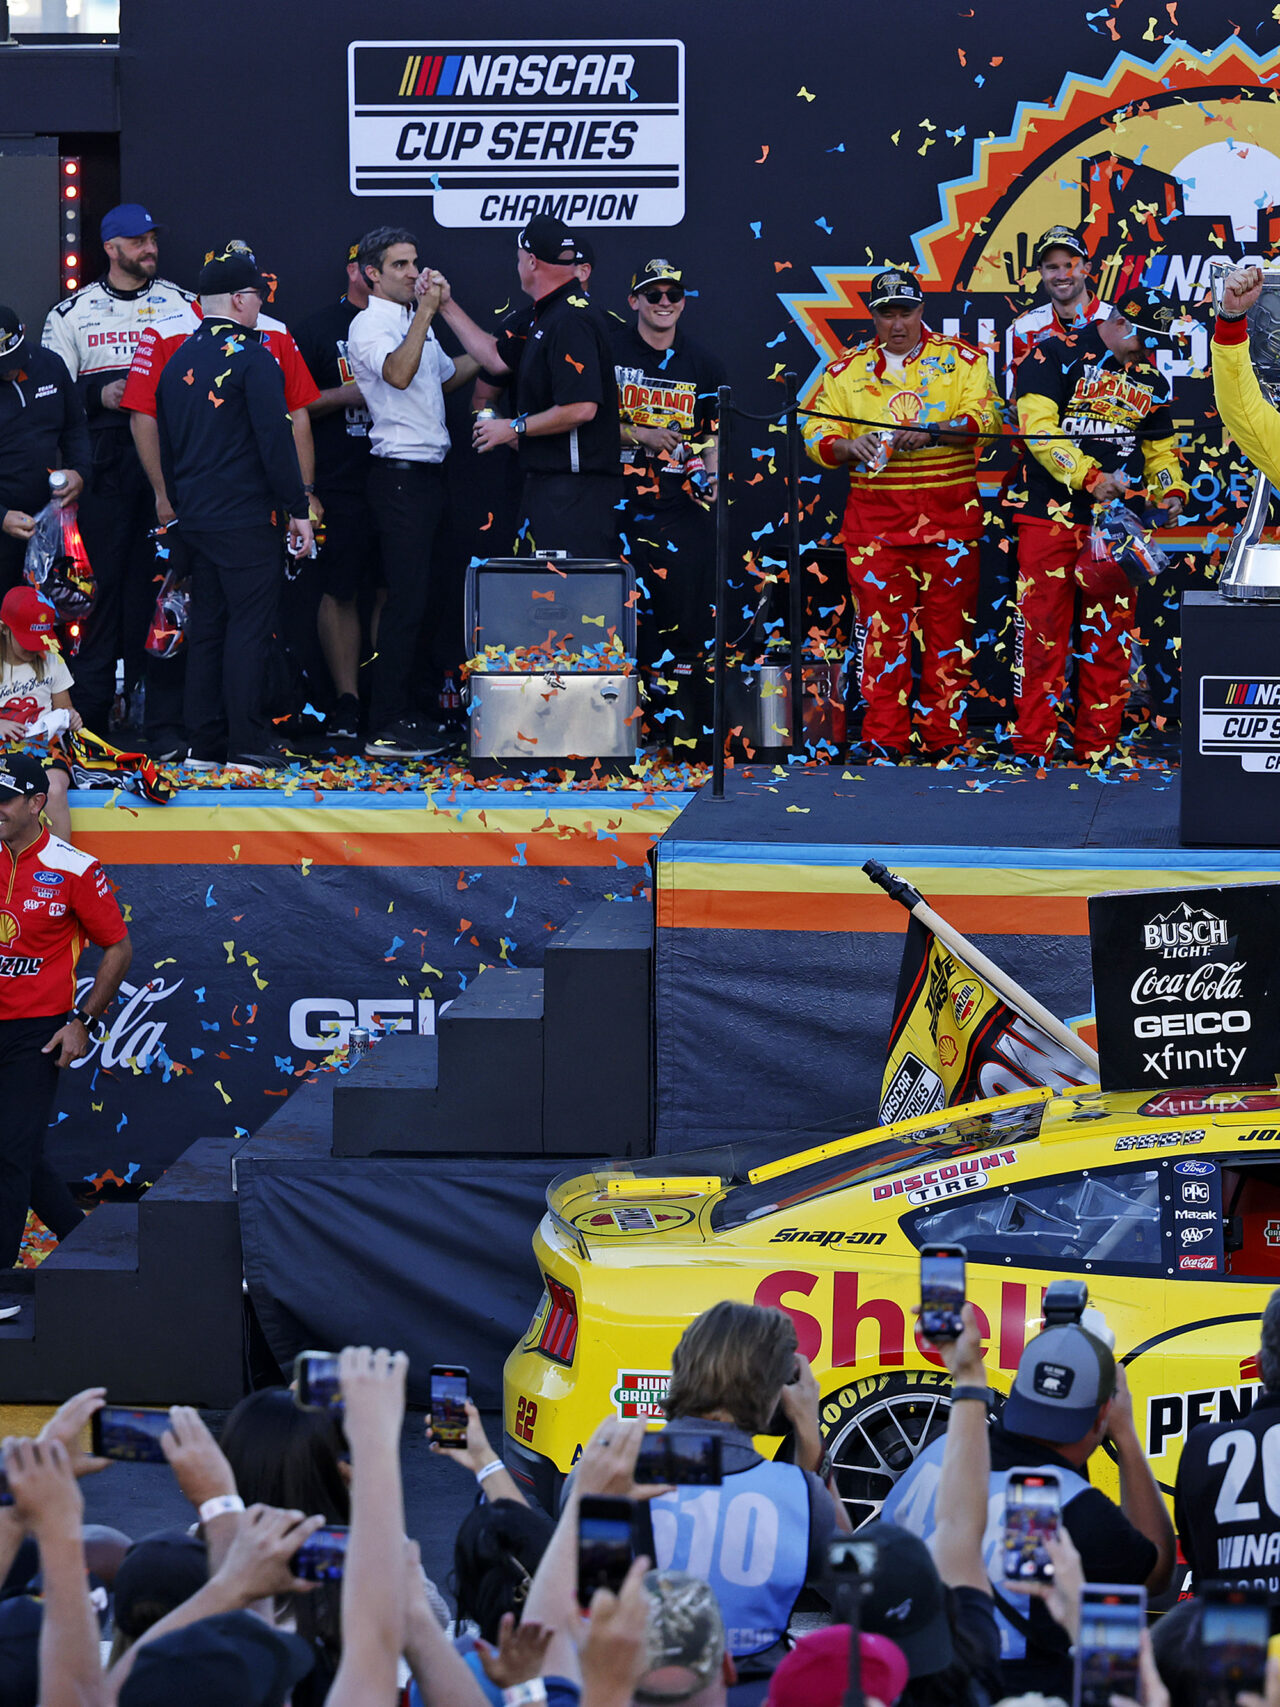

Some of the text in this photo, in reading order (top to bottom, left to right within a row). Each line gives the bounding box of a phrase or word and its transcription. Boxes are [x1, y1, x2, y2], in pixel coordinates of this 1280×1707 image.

[455, 54, 635, 96] NASCAR
[396, 121, 639, 161] CUP SERIES
[480, 194, 639, 221] CHAMPION
[88, 331, 143, 347] DISCO
[674, 383, 697, 392] JOEY
[632, 411, 650, 423] 22
[1092, 400, 1110, 413] 22
[1222, 717, 1268, 739] CUP
[38, 873, 59, 884] Ford
[1144, 919, 1229, 950] BUSCH
[1163, 946, 1208, 959] LIGHT
[1131, 962, 1248, 1005] Coca-Cola
[955, 985, 977, 1023] ENNZOIL
[289, 998, 454, 1052] GEI
[1134, 1010, 1251, 1039] GEICO
[1142, 1042, 1248, 1080] xfinity
[881, 1070, 914, 1127] NASCAR
[872, 1149, 1018, 1202] DISCOUNT
[1181, 1164, 1208, 1174] Ford
[914, 1172, 980, 1202] TIRE
[1184, 1183, 1208, 1201] PPG
[1175, 1209, 1217, 1221] Mazak
[768, 1227, 888, 1247] Snap-on
[1181, 1228, 1203, 1244] AAA
[1180, 1256, 1215, 1270] Coca-Cola
[619, 1390, 669, 1402] BROT
[515, 1396, 538, 1444] 22
[636, 1403, 665, 1416] PIZ
